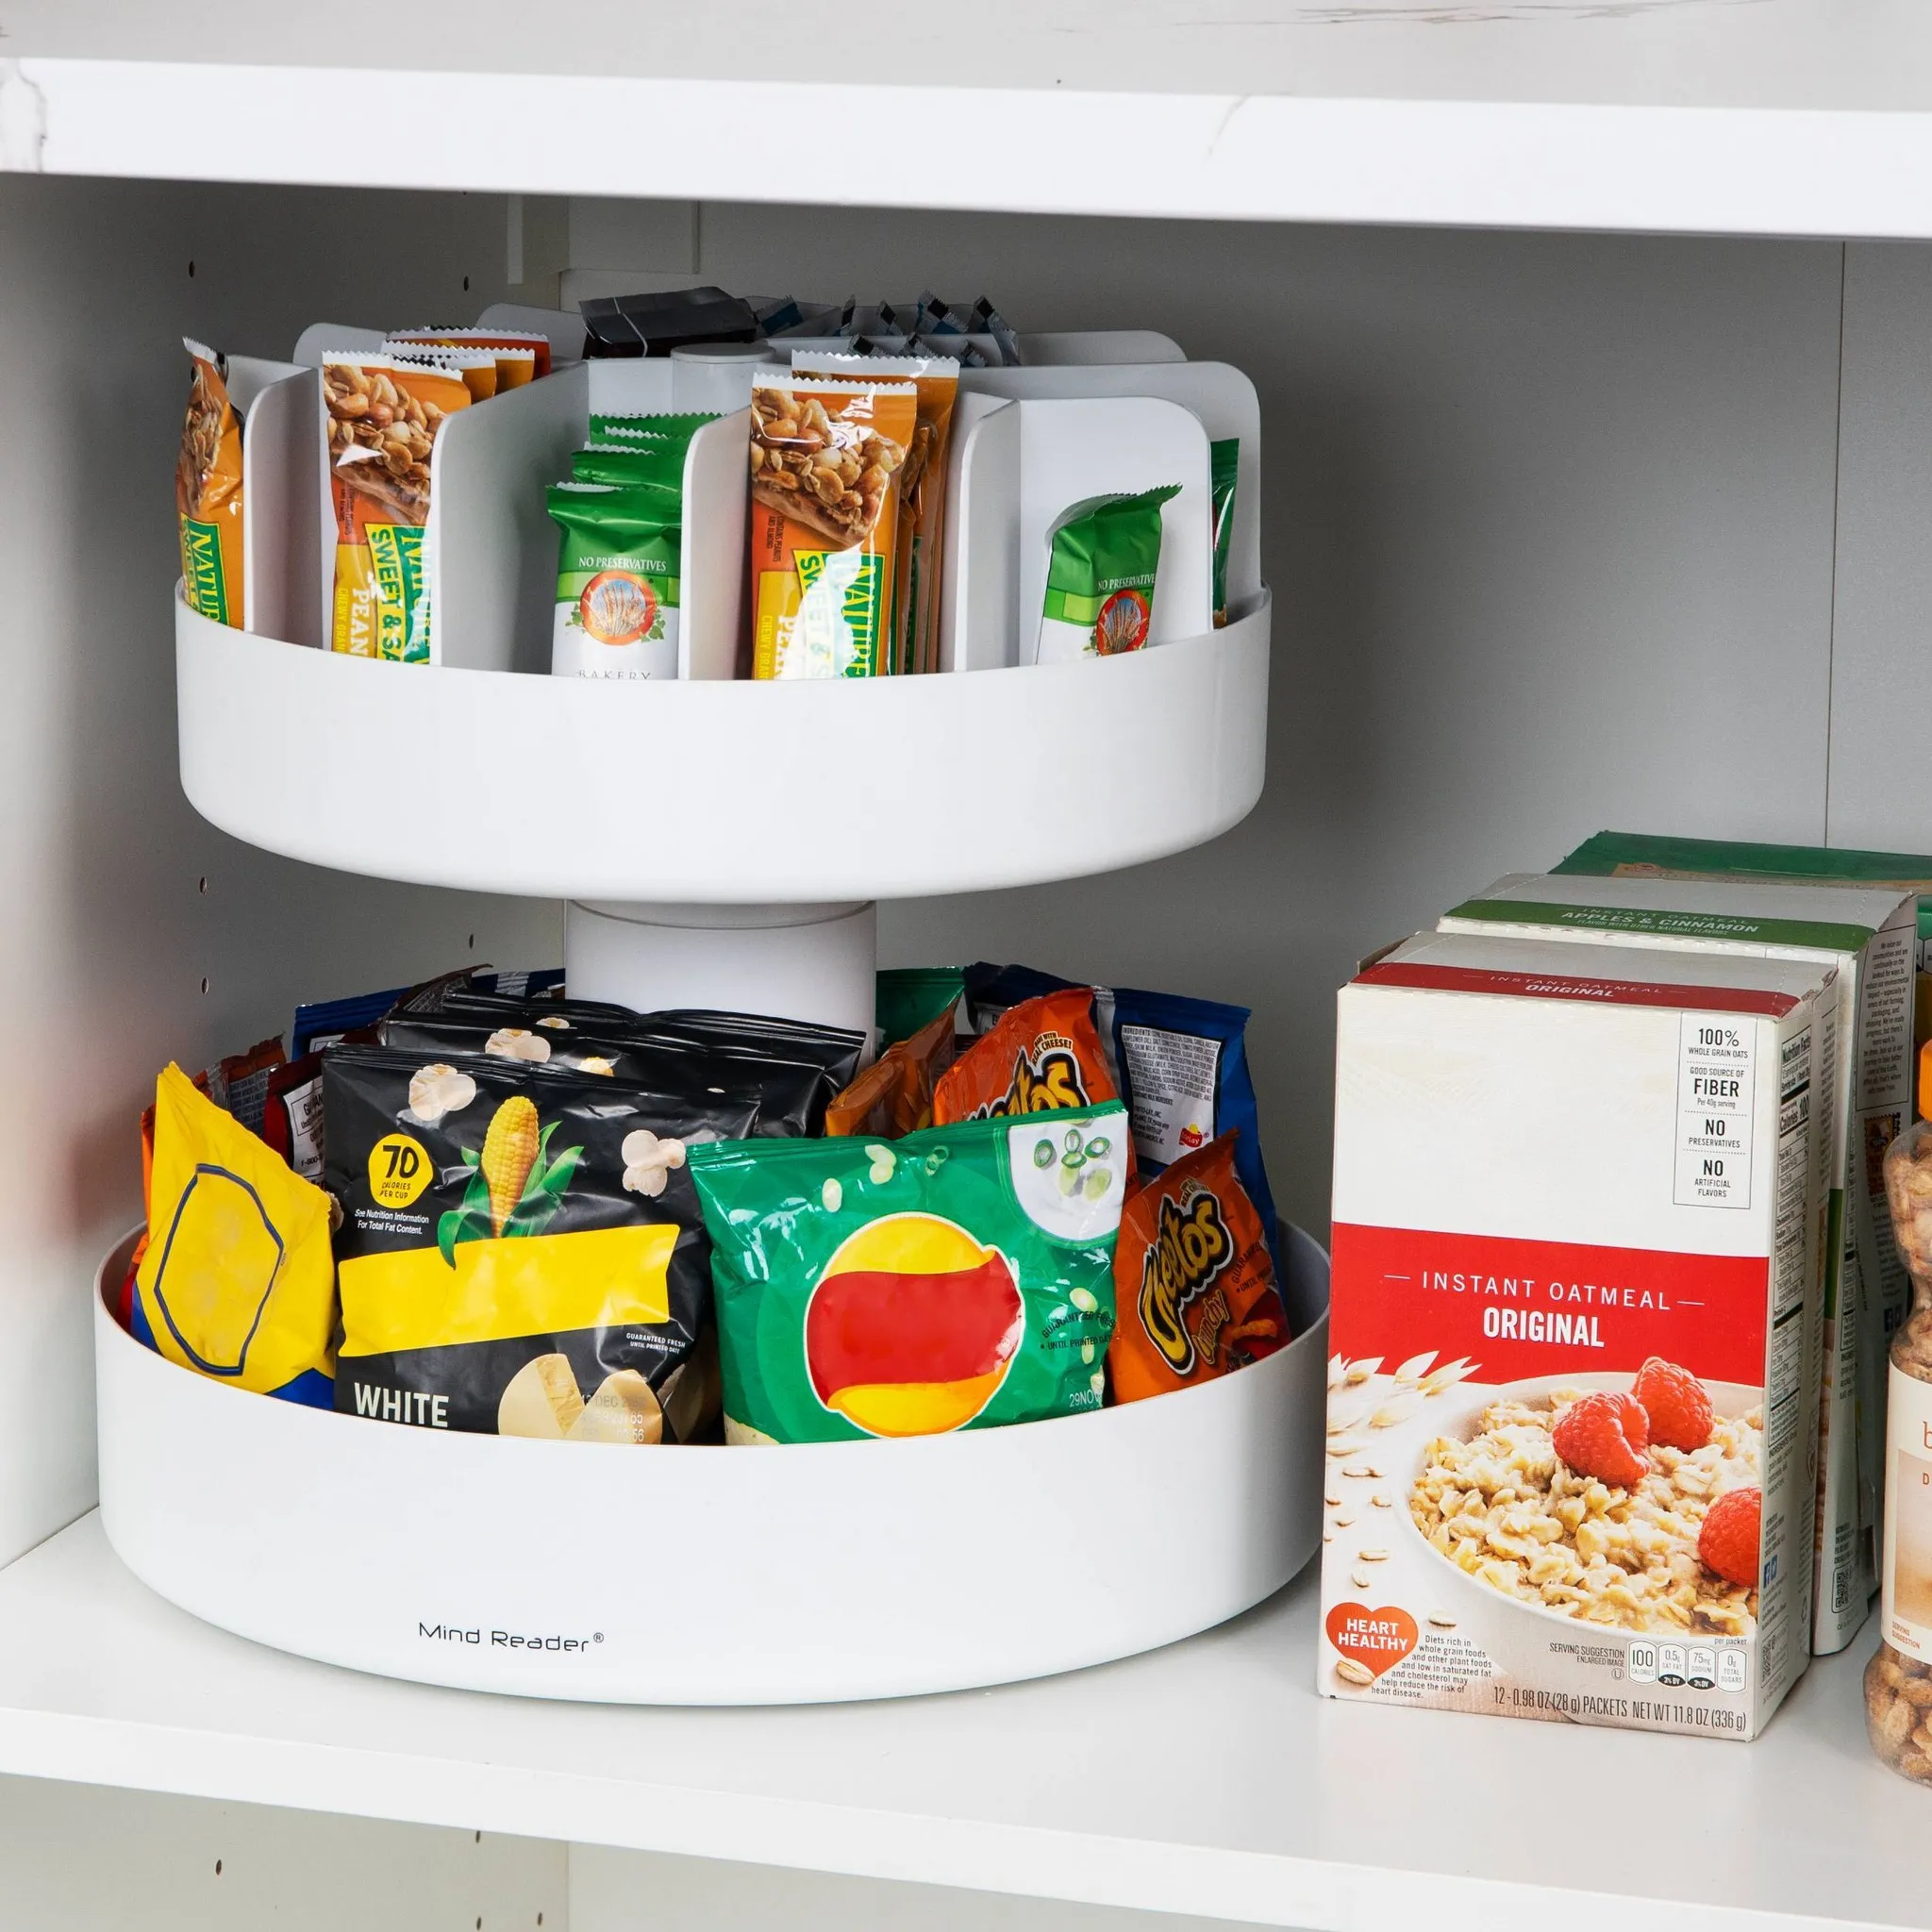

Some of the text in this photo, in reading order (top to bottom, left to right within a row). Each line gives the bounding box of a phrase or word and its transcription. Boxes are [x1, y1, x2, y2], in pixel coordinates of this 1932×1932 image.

[371, 528, 403, 608] SWEET
[579, 557, 667, 572] NO PRESERVATIVES
[1098, 579, 1108, 591] NO
[336, 588, 349, 622] CHEWY
[760, 615, 774, 646] CHEWY
[1561, 912, 1635, 923] APPLES
[1658, 919, 1759, 933] CINNAMON
[1491, 976, 1662, 993] INSTANT OATMEAL
[1524, 984, 1615, 997] ORIGINAL
[1043, 1032, 1057, 1041] WITH
[1699, 1028, 1740, 1047] 100%
[1041, 1040, 1073, 1051] CHEESE!
[1689, 1047, 1709, 1056] WHOLE
[1733, 1050, 1748, 1058] OATS
[1690, 1067, 1707, 1075] GOOD
[1708, 1068, 1735, 1077] SOURCE
[1694, 1078, 1739, 1097] FIBER
[1707, 1098, 1717, 1108] 40g
[1717, 1100, 1736, 1109] serving
[1706, 1119, 1725, 1136] NO
[1689, 1137, 1740, 1148] PRESERVATIVES
[383, 1144, 419, 1179] 70
[1703, 1159, 1724, 1176] NO
[381, 1181, 411, 1190] CALORIES
[1694, 1178, 1731, 1188] ARTIFICIAL
[1698, 1189, 1727, 1198] FLAVORS
[355, 1208, 429, 1224] See Nutrition Information
[369, 1221, 384, 1230] Total
[385, 1223, 395, 1232] Fat
[396, 1224, 423, 1235] Content.
[1140, 1196, 1229, 1372] Cheetos
[1422, 1272, 1672, 1310] INSTANT OATMEAL
[1041, 1311, 1094, 1338] GUARANTEED
[1483, 1307, 1605, 1348] ORIGINAL
[626, 1332, 686, 1348] GUARANTEED FRESH
[1048, 1341, 1067, 1350] UNTIL
[1070, 1337, 1097, 1348] PRINTED
[354, 1382, 449, 1428] WHITE
[419, 1622, 480, 1643] Mind
[1347, 1618, 1399, 1636] HEART
[1892, 1621, 1910, 1637] SERVING
[1338, 1632, 1408, 1651] HEALTHY
[1424, 1635, 1444, 1644] Diets
[1446, 1637, 1462, 1646] rich
[1892, 1629, 1921, 1650] SUGGESTION
[1419, 1644, 1486, 1658] whole grain foods
[1549, 1642, 1624, 1658] SERVING SUGGESTION
[1632, 1649, 1654, 1667] 100
[1411, 1653, 1492, 1668] and other plant foods
[1576, 1656, 1624, 1667] ENLARGED IMAGE
[1417, 1663, 1431, 1672] low
[1442, 1665, 1478, 1676] saturated
[1480, 1669, 1491, 1677] fat
[1381, 1678, 1398, 1689] help
[1400, 1680, 1425, 1690] reduce
[1427, 1682, 1440, 1690] the
[1441, 1684, 1455, 1692] risk
[1407, 1672, 1451, 1682] cholesterol
[1453, 1676, 1468, 1685] may
[1371, 1687, 1424, 1699] heart disease.
[1493, 1685, 1506, 1705] 12
[1513, 1689, 1535, 1707] 0.98
[1537, 1691, 1550, 1709] OZ
[1552, 1691, 1568, 1712] (28
[1570, 1695, 1581, 1715] g)
[1583, 1695, 1628, 1717] PACKETS
[1633, 1701, 1651, 1720] NET
[1653, 1703, 1671, 1723] WT
[1673, 1705, 1693, 1724] 11.8
[1696, 1707, 1708, 1725] OZ
[1711, 1708, 1734, 1729] (336
[1736, 1712, 1746, 1732] g)
